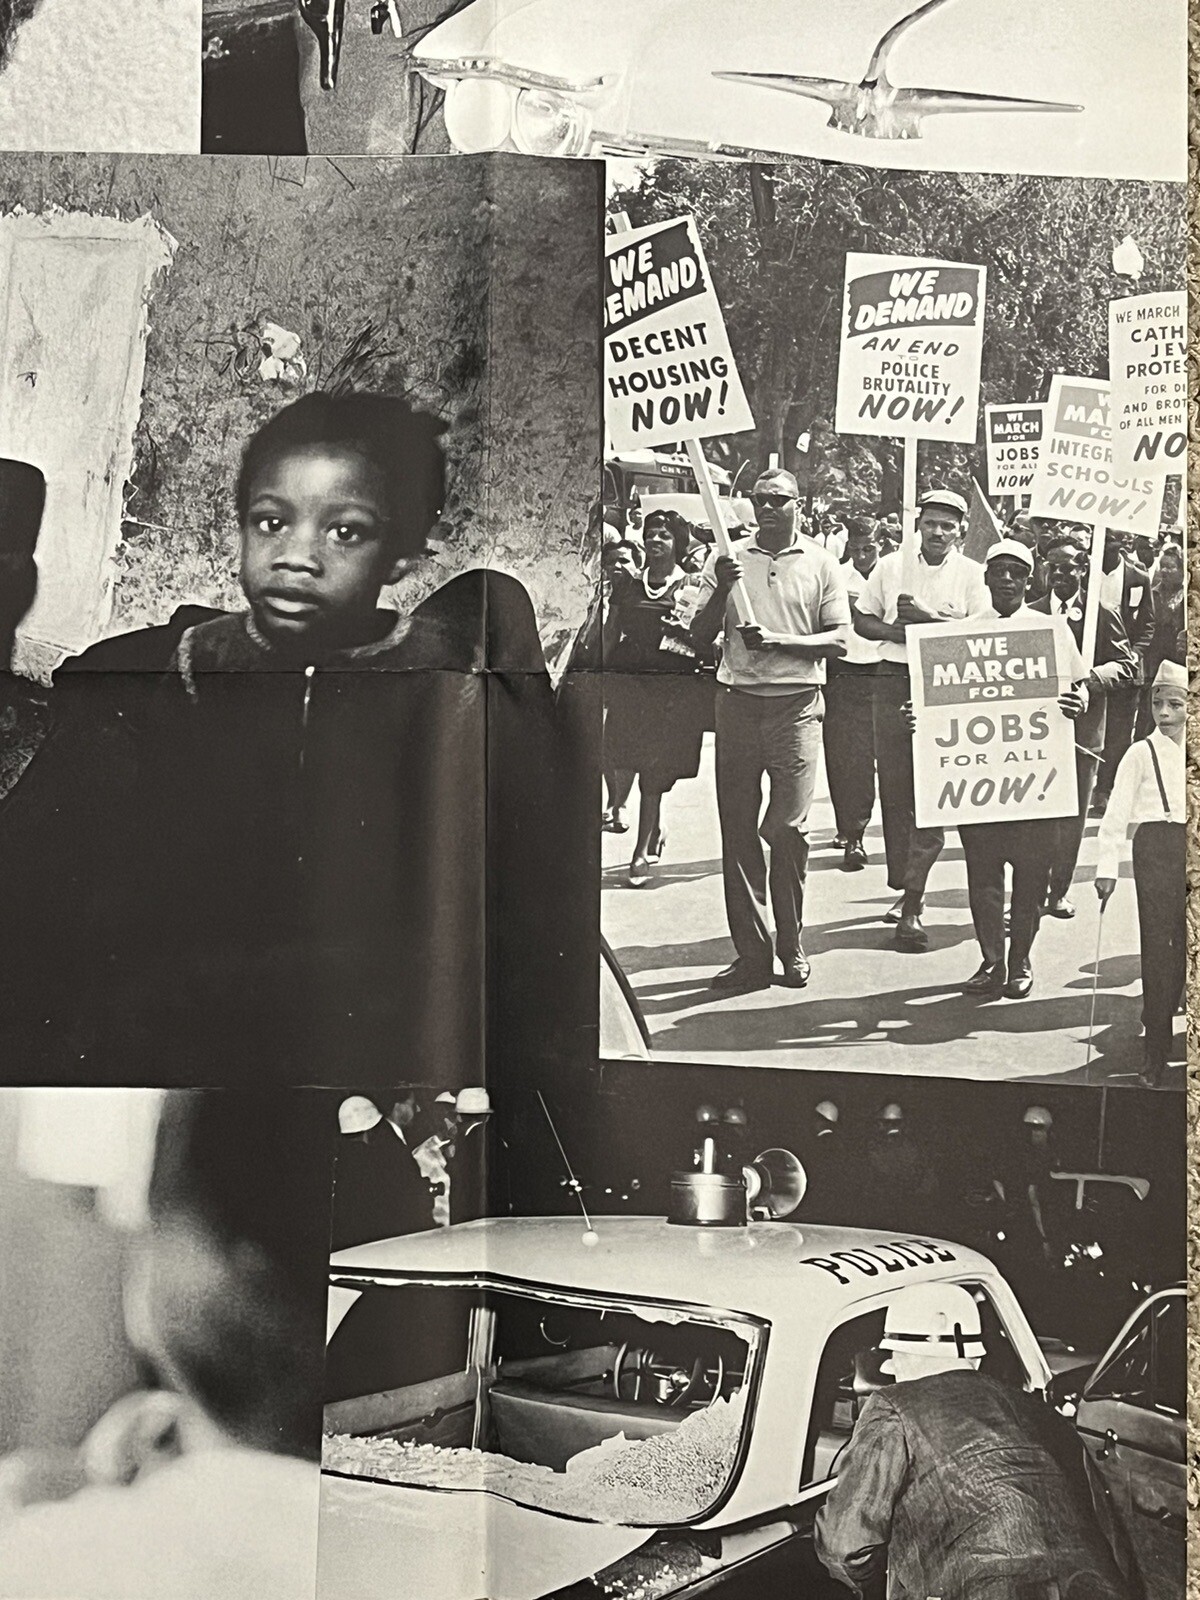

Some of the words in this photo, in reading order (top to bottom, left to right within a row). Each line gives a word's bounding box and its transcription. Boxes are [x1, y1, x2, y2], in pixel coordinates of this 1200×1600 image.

[609, 241, 654, 287] WE
[604, 257, 697, 328] EMAND
[889, 270, 940, 298] WE
[854, 292, 973, 331] DEMAND
[1116, 310, 1132, 323] WE
[1137, 305, 1180, 321] MARCH
[609, 322, 707, 363] DECENT
[1130, 325, 1184, 343] CATH
[862, 336, 901, 351] AN
[907, 340, 960, 357] END
[608, 356, 728, 398] HOUSING
[881, 361, 940, 379] POLICE
[863, 377, 951, 396] BRUTALITY
[1144, 384, 1167, 395] FOR
[632, 380, 729, 432] NOW!
[858, 394, 965, 424] NOW!
[1123, 402, 1148, 414] AND
[1006, 412, 1023, 422] WE
[1119, 420, 1131, 430] OF
[1136, 417, 1154, 427] ALL
[1159, 414, 1182, 425] MEN
[993, 421, 1039, 435] MARCH
[996, 446, 1039, 462] JOBS
[1133, 431, 1188, 462] NO
[996, 473, 1034, 488] NOW
[1048, 487, 1147, 520] NOW!
[966, 637, 1008, 658] WE
[932, 656, 1048, 687] MARCH
[969, 684, 1015, 699] FOR
[934, 711, 1050, 748] JOBS
[940, 753, 988, 768] FOR
[1004, 749, 1047, 763] ALL
[937, 766, 1058, 810] NOW!
[799, 1239, 956, 1285] POLICE
